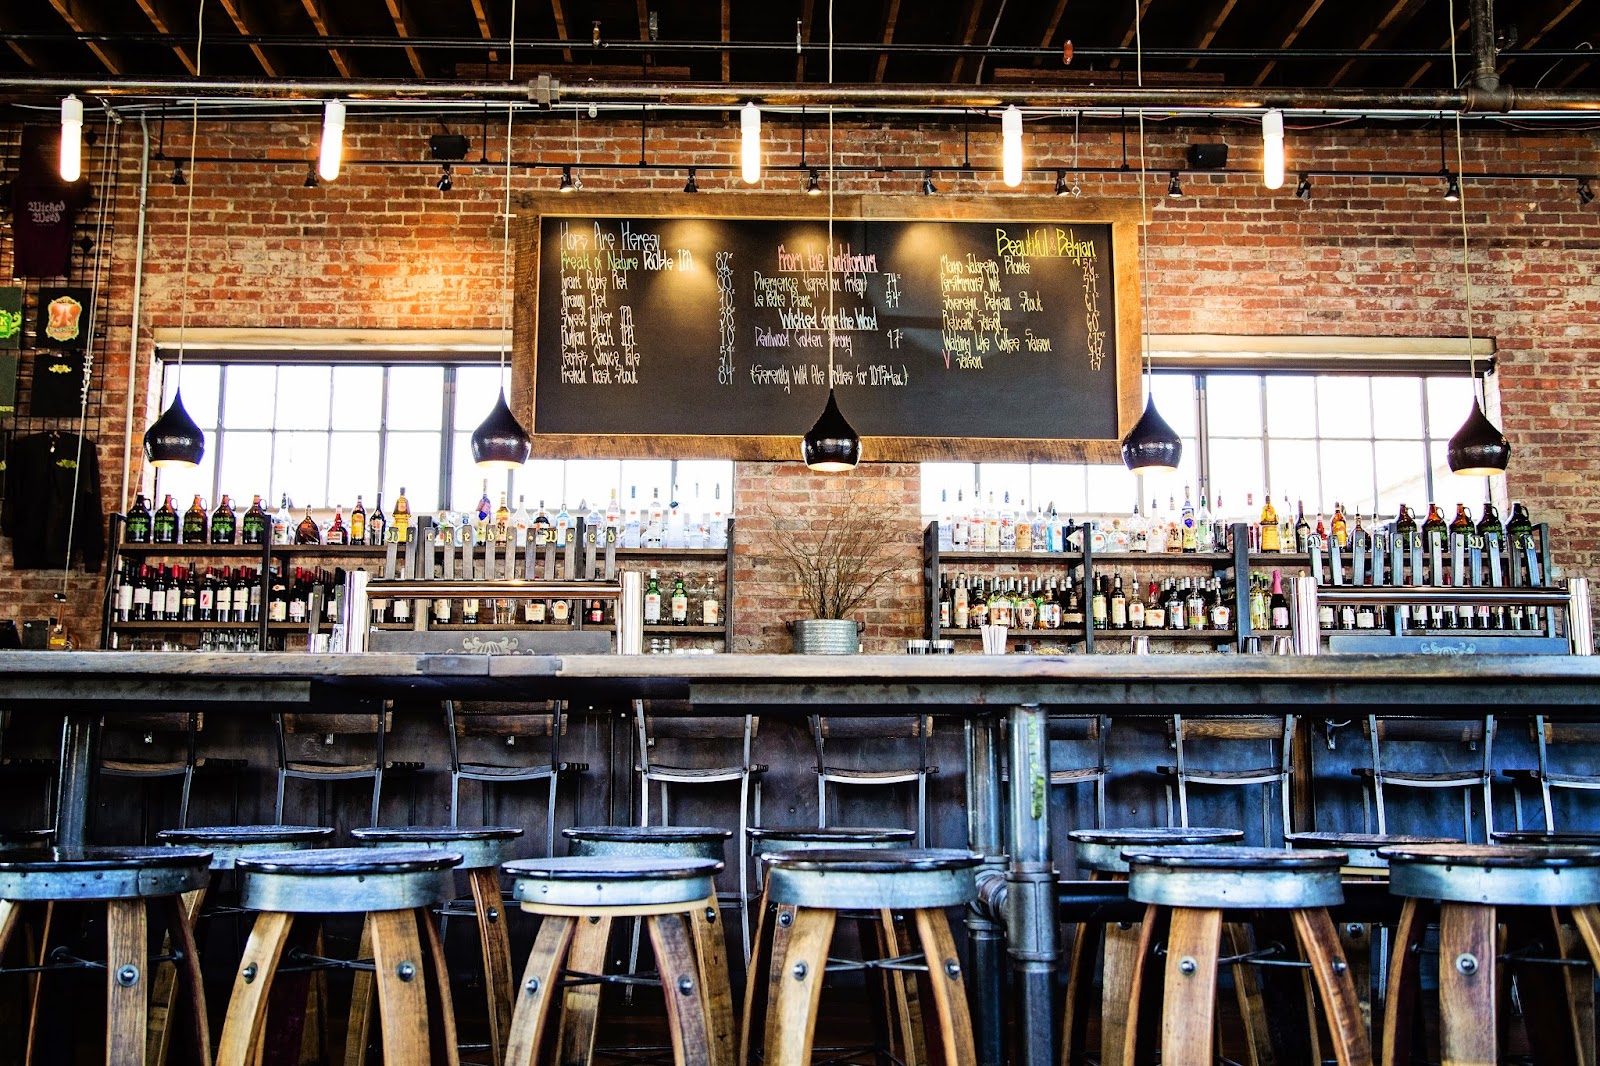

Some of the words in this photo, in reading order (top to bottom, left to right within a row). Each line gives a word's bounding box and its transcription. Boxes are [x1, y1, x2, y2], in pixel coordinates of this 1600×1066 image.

[27, 200, 66, 212] Wicked
[32, 211, 61, 223] Weed
[560, 221, 588, 254] Hops
[594, 221, 615, 250] Are
[621, 221, 660, 252] Heresy
[996, 227, 1049, 258] Beautiful
[1056, 228, 1097, 266] Belgian
[560, 250, 591, 270] Freak
[594, 250, 602, 270] of
[607, 250, 638, 270] Nature
[677, 249, 695, 272] IPA
[777, 244, 804, 271] From
[807, 243, 825, 271] the
[1004, 254, 1030, 275] Blonde
[612, 269, 628, 289] Red
[753, 271, 798, 291] Divergence
[591, 289, 608, 308] Red
[753, 290, 763, 307] Le
[983, 291, 1012, 316] Belgian
[1019, 291, 1043, 312] Stout
[620, 306, 635, 327] IPA
[778, 306, 818, 329] Wicked
[840, 307, 854, 329] the
[854, 306, 878, 330] Wood
[942, 310, 974, 331] Reticent
[977, 310, 1003, 331] Saison
[620, 324, 638, 346] IPA
[794, 327, 823, 347] Golden
[995, 328, 1019, 353] Coffee
[1025, 329, 1052, 351] Saison
[594, 345, 619, 366] Choice
[625, 345, 640, 366] Pale
[942, 349, 950, 370] V
[956, 350, 983, 370] Saison
[561, 364, 587, 384] French
[614, 365, 638, 384] Stout
[811, 364, 825, 385] Ale
[856, 364, 867, 385] for
